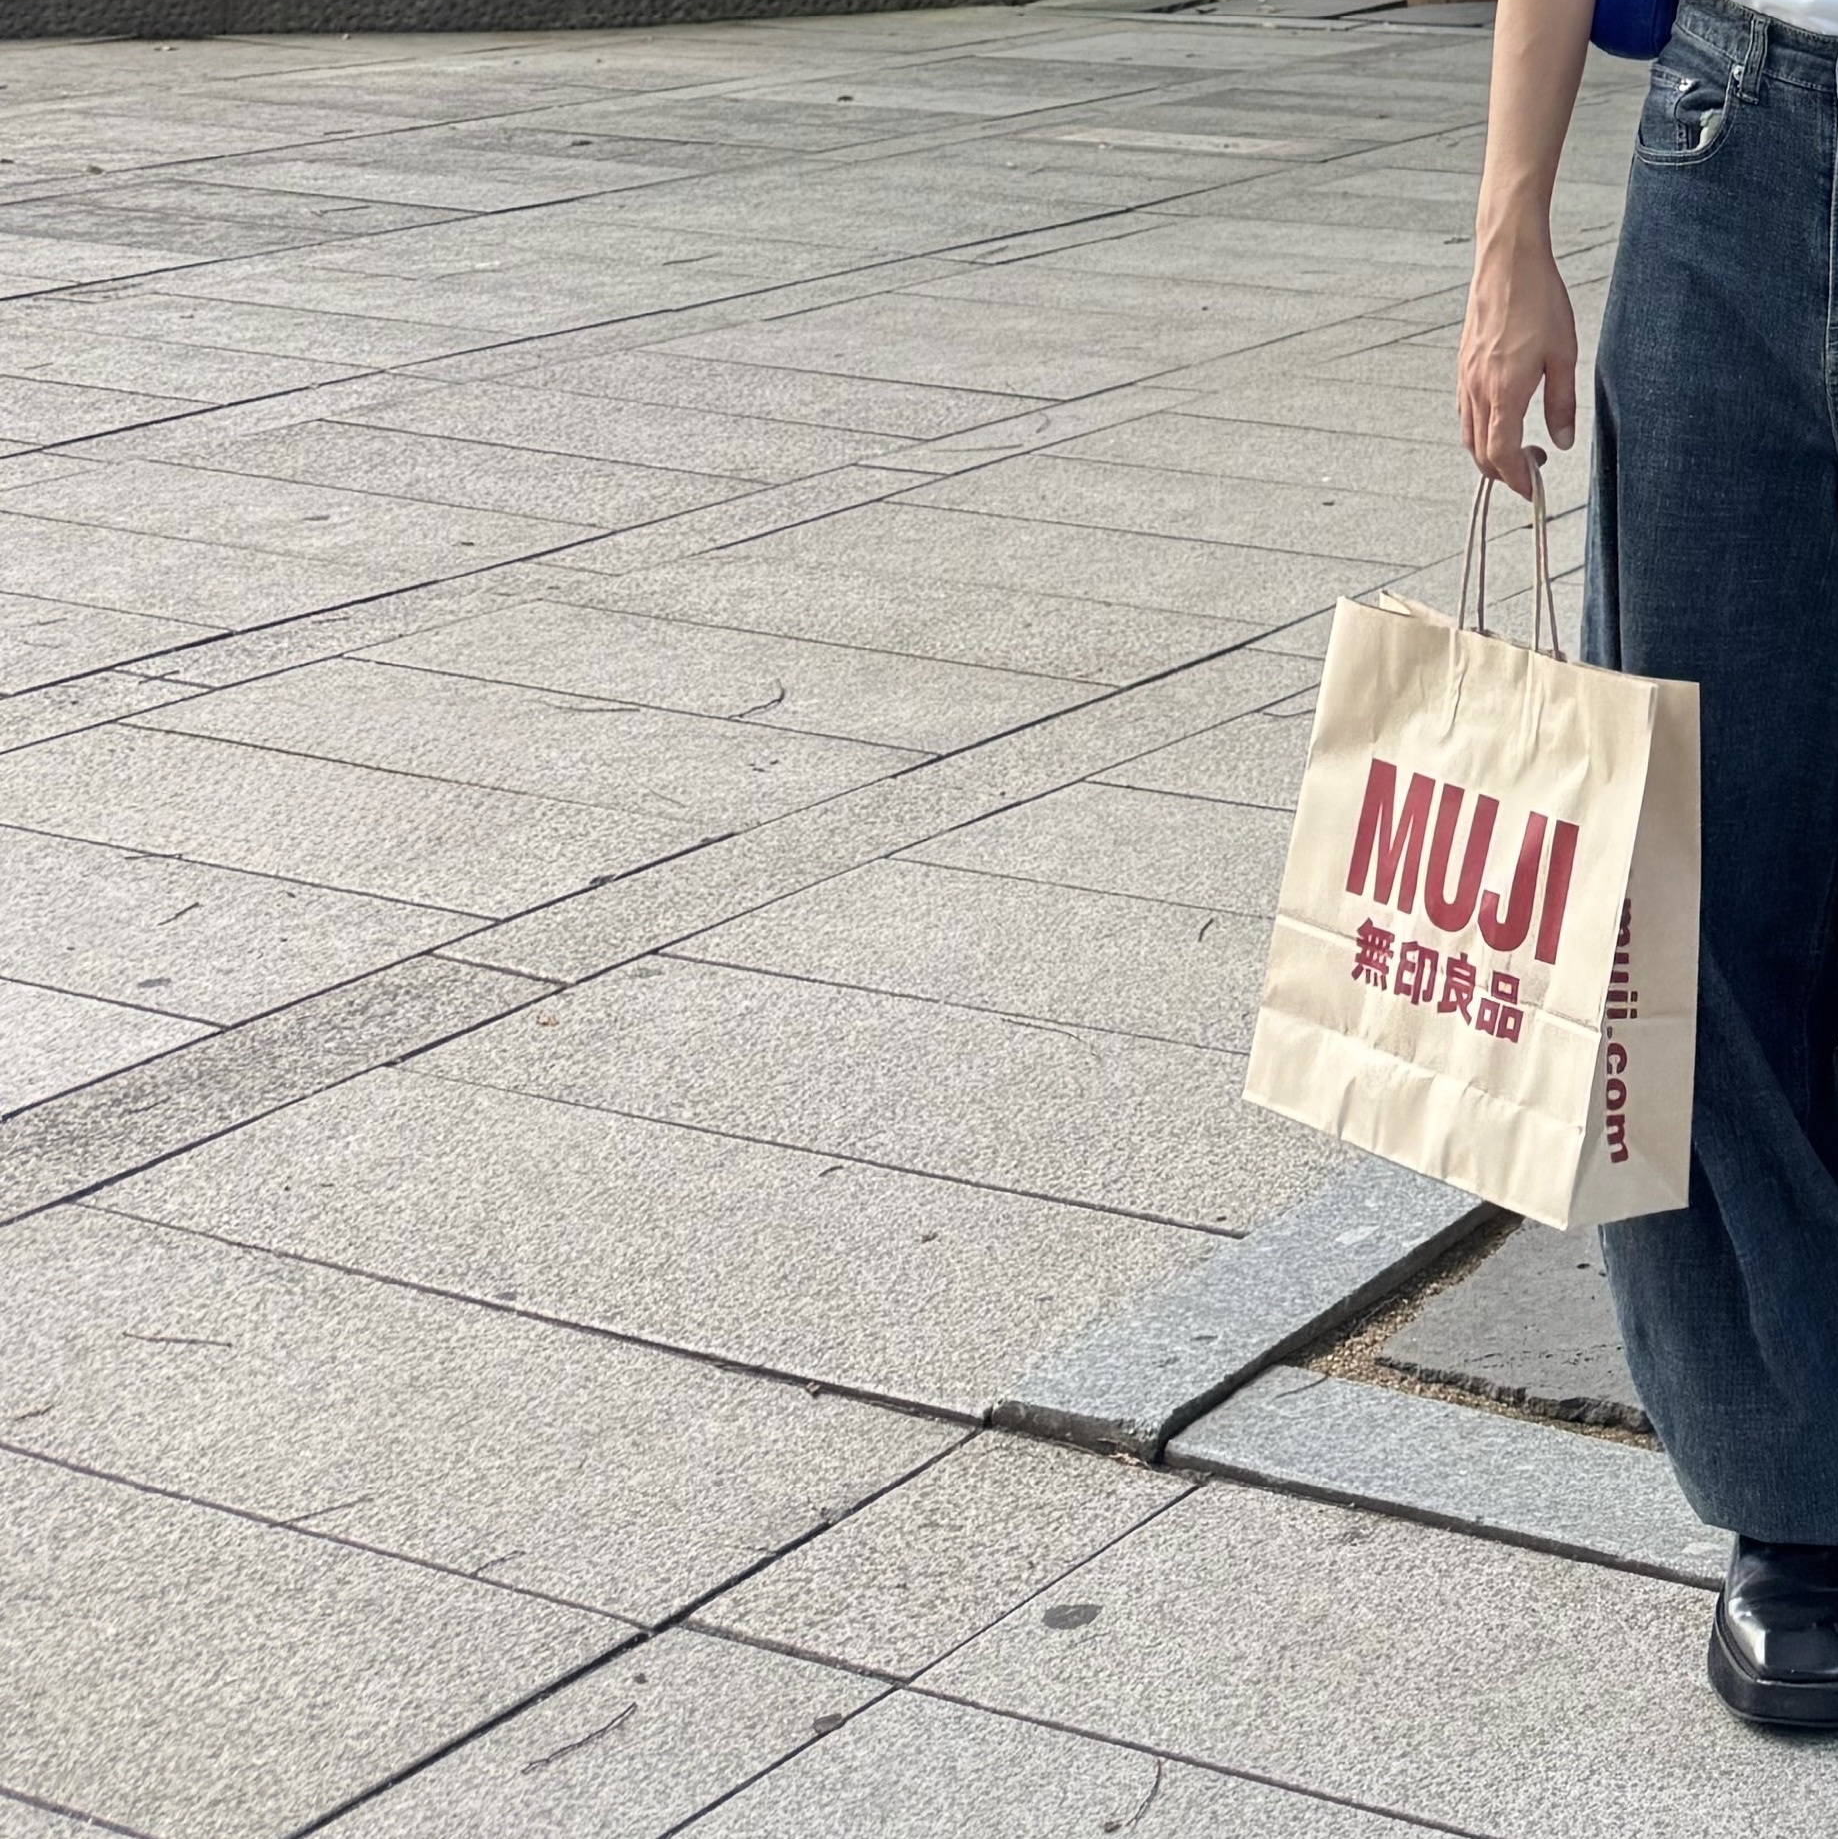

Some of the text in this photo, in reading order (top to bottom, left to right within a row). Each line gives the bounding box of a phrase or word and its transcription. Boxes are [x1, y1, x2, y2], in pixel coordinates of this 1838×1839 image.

[1346, 757, 1579, 965] MUJI
[1351, 917, 1524, 1043] 無印良品
